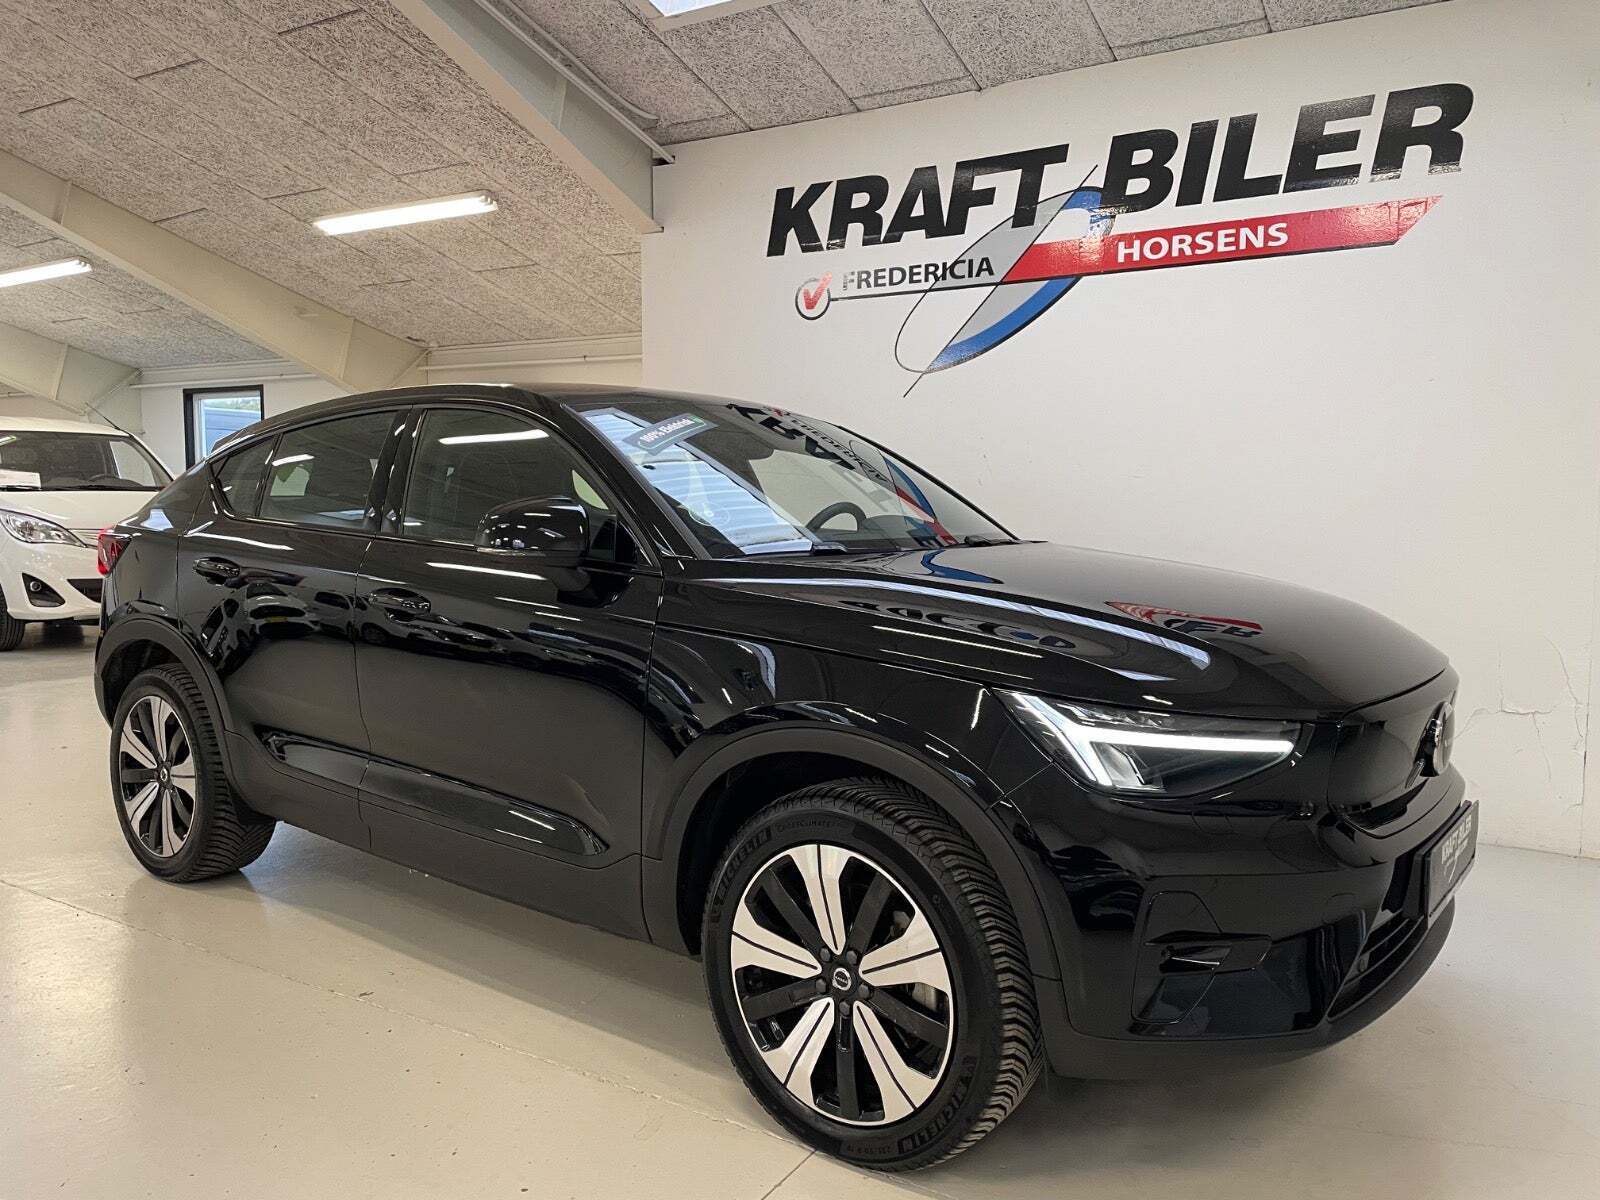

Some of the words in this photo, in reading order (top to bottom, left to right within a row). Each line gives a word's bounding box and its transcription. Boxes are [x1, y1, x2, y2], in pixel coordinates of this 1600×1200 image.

[767, 144, 1069, 257] KRAFT
[1101, 83, 1474, 213] BILER
[1116, 223, 1289, 263] HORSENS
[843, 256, 995, 291] FREDERICIA
